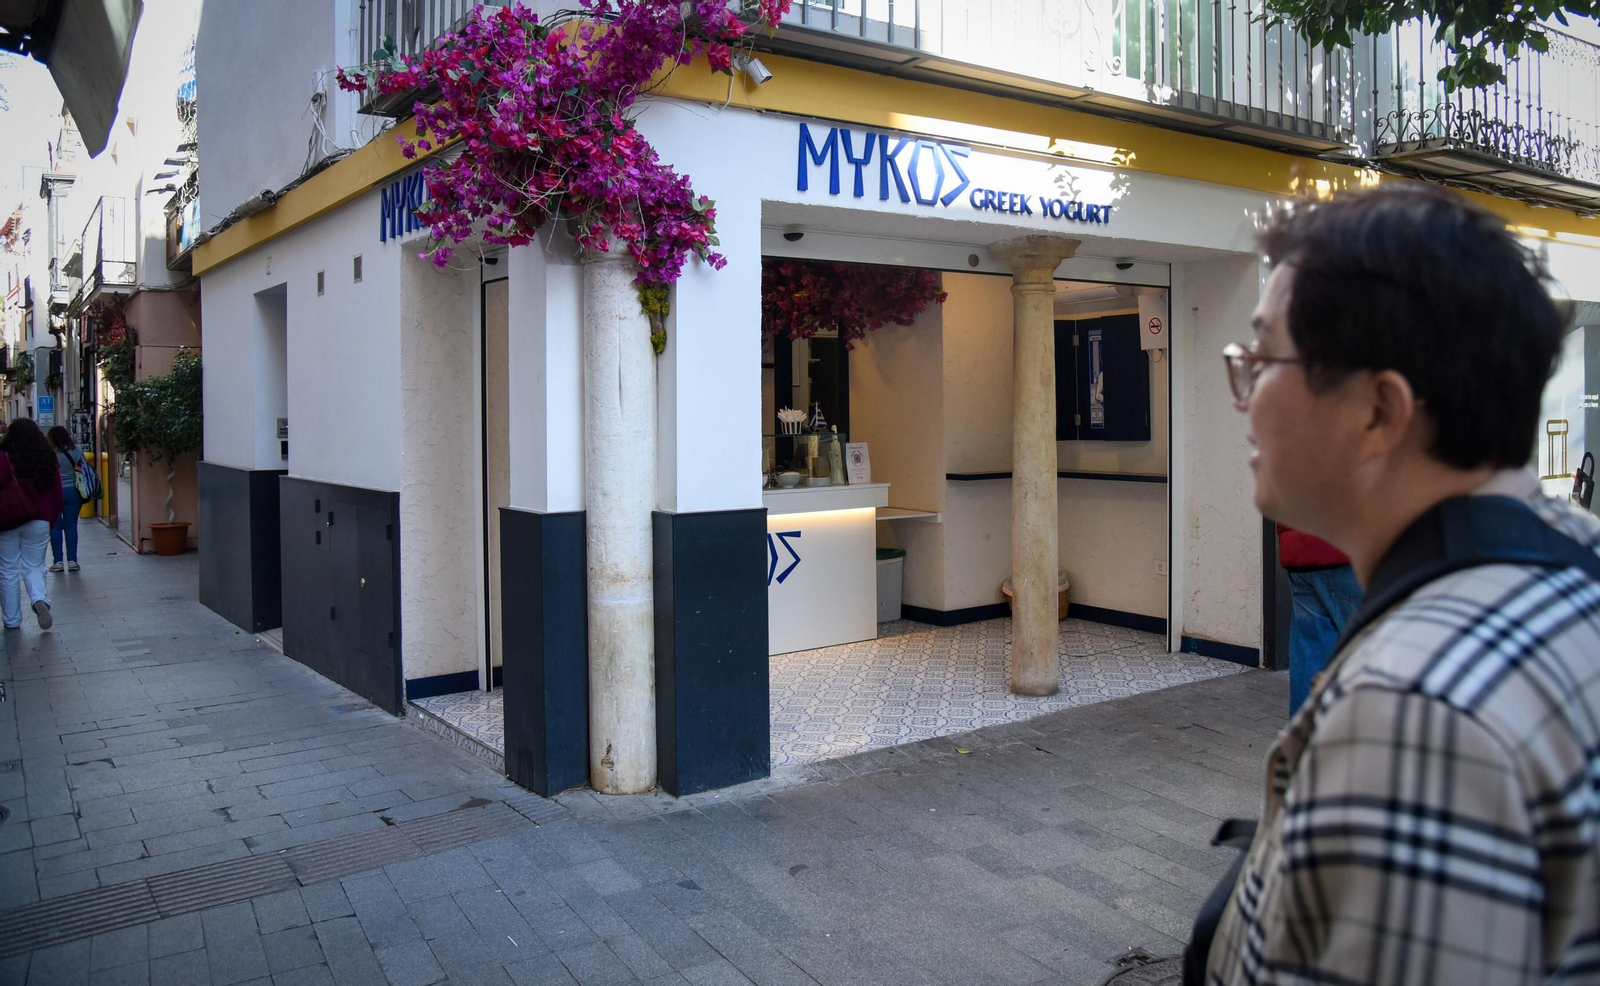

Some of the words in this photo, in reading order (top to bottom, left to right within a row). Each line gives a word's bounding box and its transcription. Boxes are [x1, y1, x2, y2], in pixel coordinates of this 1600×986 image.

[796, 122, 972, 207] MYKOS
[969, 187, 1033, 215] GREEK
[1039, 196, 1113, 224] YOGURT
